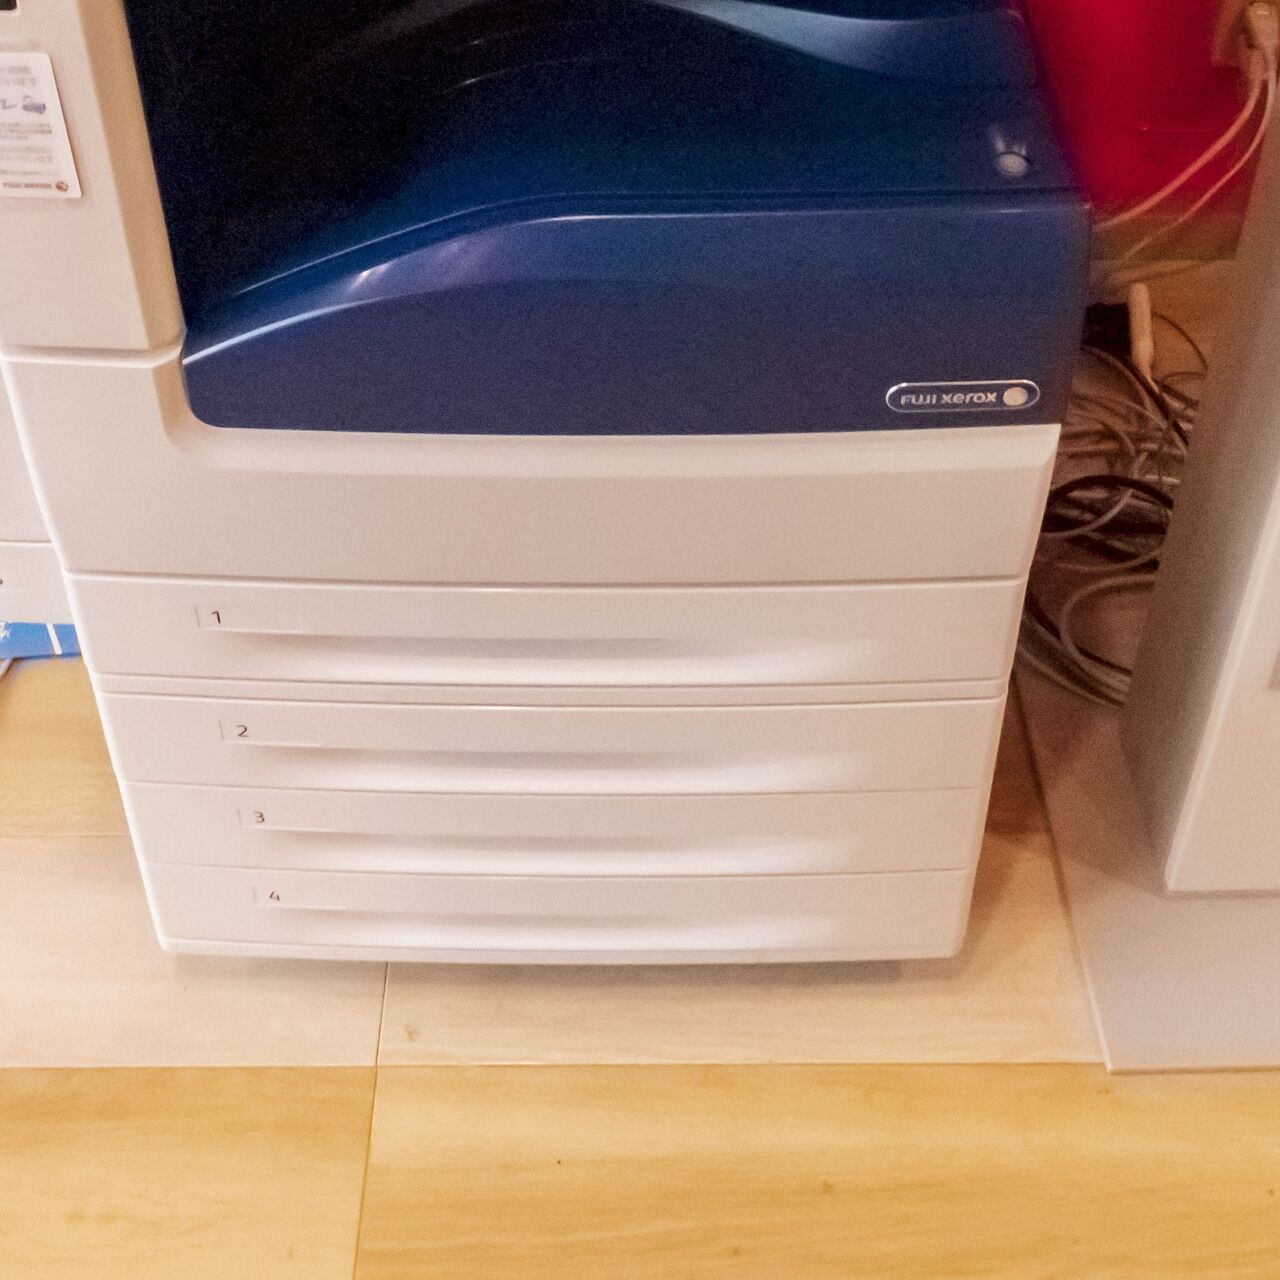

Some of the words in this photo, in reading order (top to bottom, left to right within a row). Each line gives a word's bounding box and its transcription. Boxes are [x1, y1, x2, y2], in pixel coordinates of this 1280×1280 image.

[900, 394, 937, 405] FUJI
[211, 610, 221, 625] 1
[236, 724, 249, 738] 2
[254, 810, 265, 823] 3
[269, 891, 280, 902] 4
